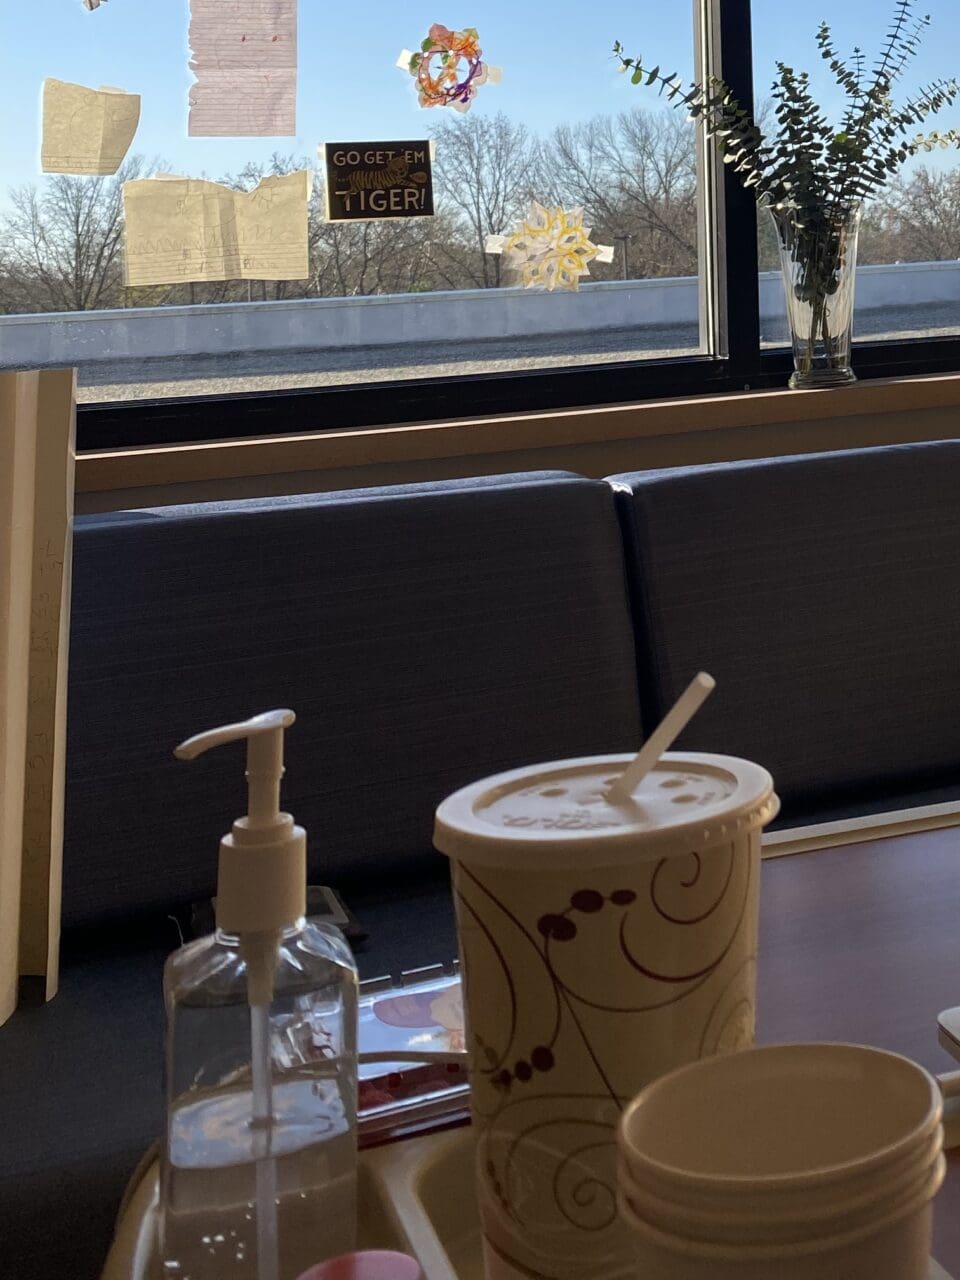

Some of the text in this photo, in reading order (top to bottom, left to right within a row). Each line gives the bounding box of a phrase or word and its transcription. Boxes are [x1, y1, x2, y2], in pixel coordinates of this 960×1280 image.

[333, 151, 360, 166] GO
[364, 151, 396, 164] GET
[335, 188, 426, 211] TIGER!
